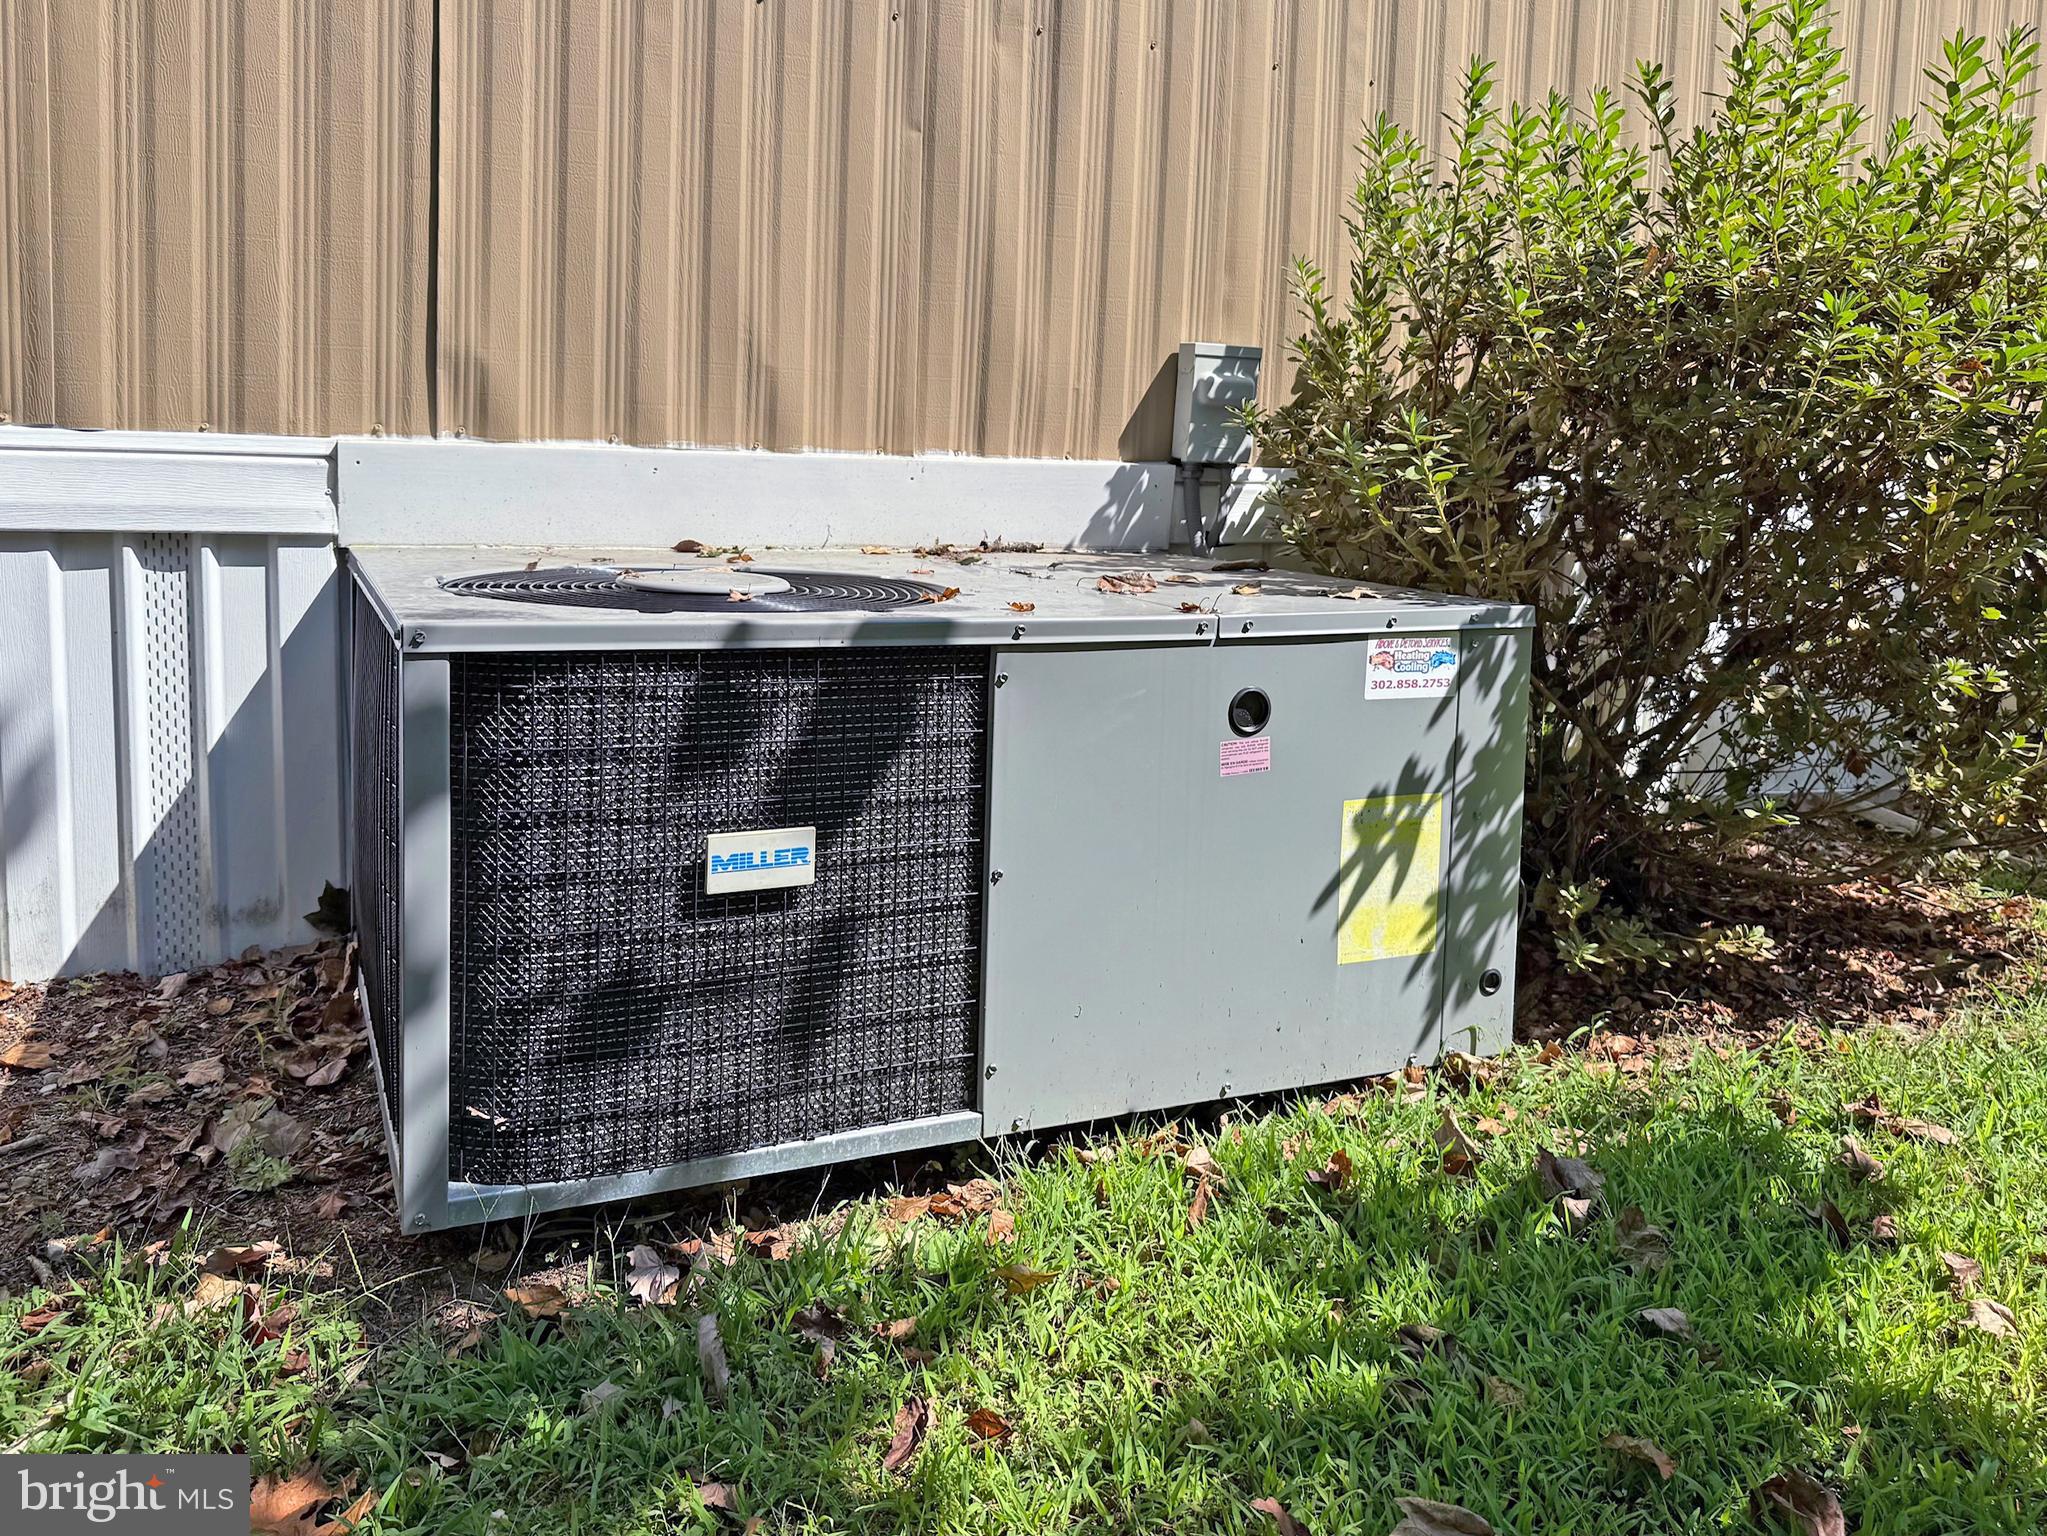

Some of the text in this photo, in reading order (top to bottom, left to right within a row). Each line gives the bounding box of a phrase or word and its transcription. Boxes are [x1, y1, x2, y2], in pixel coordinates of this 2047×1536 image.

[1394, 650, 1430, 661] Heating
[1394, 661, 1429, 673] Cooling
[1370, 678, 1451, 690] 302.858.2753
[711, 847, 811, 874] MILLER
